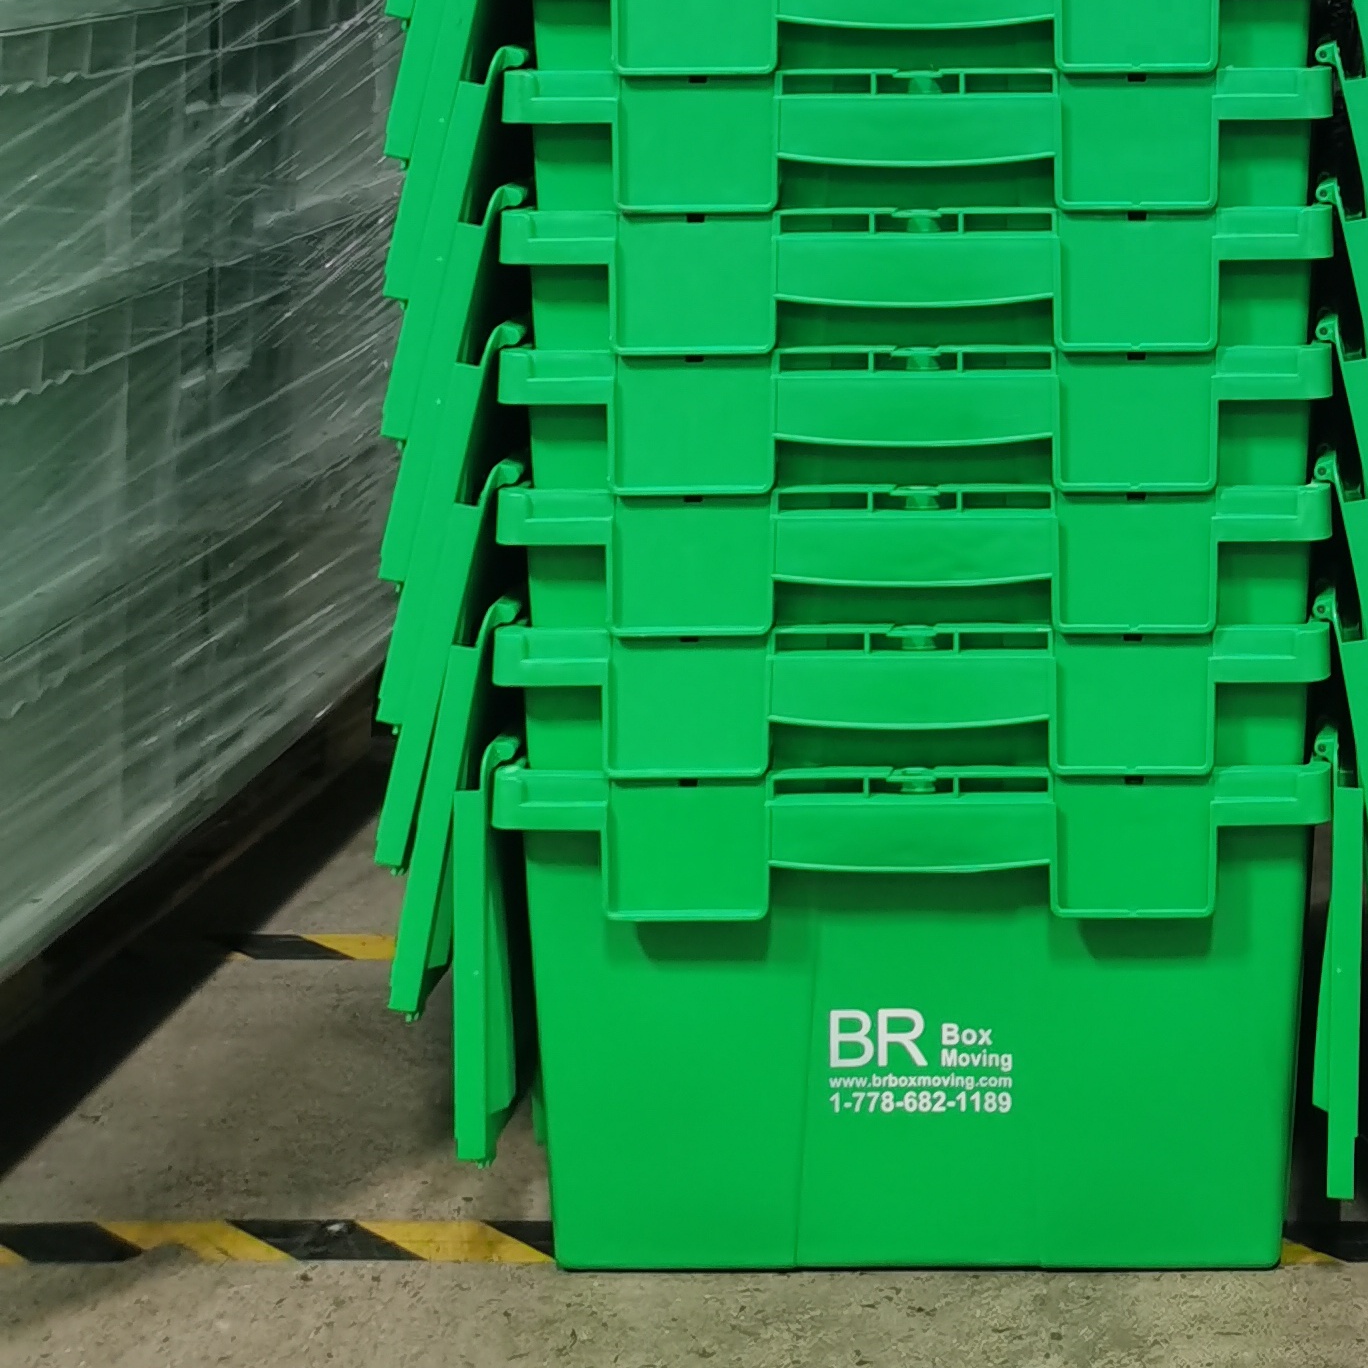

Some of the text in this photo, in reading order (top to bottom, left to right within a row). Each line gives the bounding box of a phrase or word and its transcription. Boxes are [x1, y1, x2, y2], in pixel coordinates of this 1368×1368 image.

[829, 1008, 928, 1068] BR
[941, 1022, 992, 1046] Box
[940, 1048, 1013, 1072] Moving
[829, 1073, 1013, 1090] www.brboxmoving.com
[829, 1091, 1012, 1113] 1-778-682-1189
